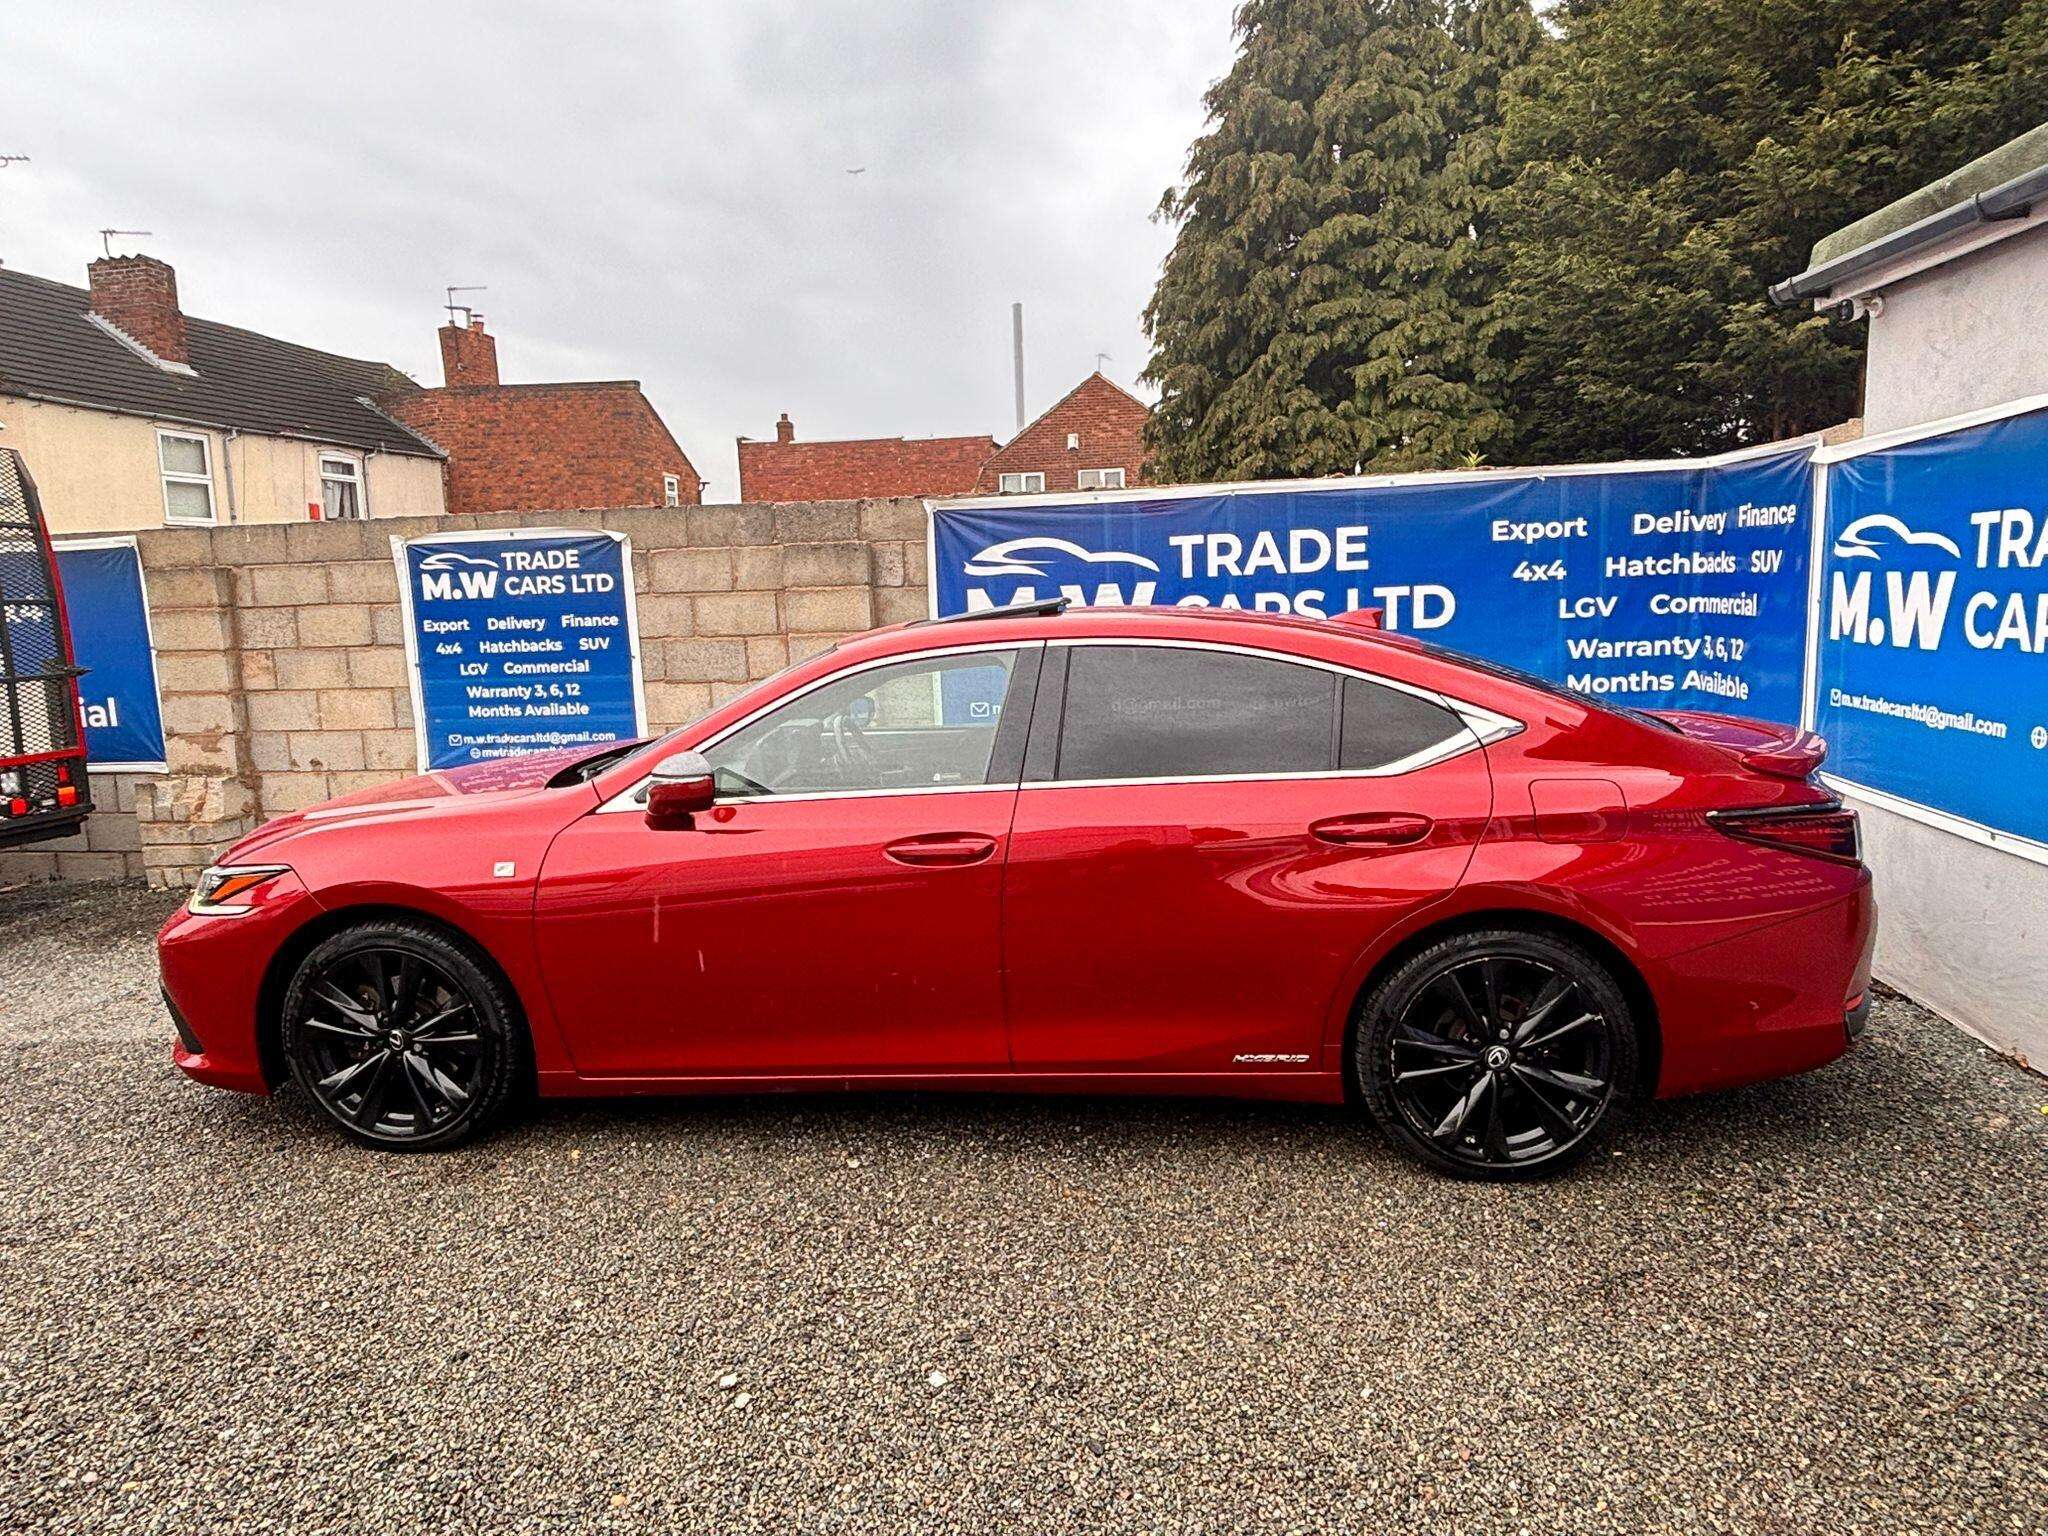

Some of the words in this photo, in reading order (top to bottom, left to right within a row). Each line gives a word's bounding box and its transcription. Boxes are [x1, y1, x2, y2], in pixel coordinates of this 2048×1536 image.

[1492, 517, 1588, 544] Export
[1633, 509, 1727, 535] Delivery
[1738, 503, 1797, 528] Finance
[501, 550, 580, 571] TRADE
[1169, 526, 1369, 578] TRADE
[1513, 559, 1567, 582] 4x4
[1605, 551, 1736, 578] Hatchbacks
[1751, 550, 1783, 573] SUV
[421, 571, 499, 600] M.W
[504, 575, 565, 596] CARS
[571, 573, 614, 593] LTD
[1559, 596, 1618, 619] LGV
[1650, 592, 1758, 617] Commercial
[1830, 571, 1957, 651] M.W
[423, 619, 470, 634] Export
[487, 616, 546, 632] Delivery
[561, 614, 619, 628] Finance
[436, 642, 462, 655] 4x4
[479, 639, 563, 654] Hatchbacks
[579, 637, 609, 650] SUV
[1567, 635, 1702, 660] Warranty
[1703, 635, 1715, 659] 3,
[1716, 637, 1729, 662] 6,
[1730, 638, 1746, 661] 12
[460, 663, 488, 676] LGV
[503, 659, 589, 675] Commercial
[466, 686, 531, 700] Warranty
[534, 684, 547, 699] 3,
[550, 684, 563, 698] 6,
[566, 683, 581, 696] 12
[1567, 670, 1674, 694] Months
[1681, 669, 1749, 700] Available
[78, 696, 118, 728] ial
[469, 704, 522, 718] Months
[524, 703, 589, 717] Available
[1841, 693, 2007, 738] m.w.tradecarsltd@gmail.com
[464, 731, 616, 745] m.w.tradecarsltd@gmail.com
